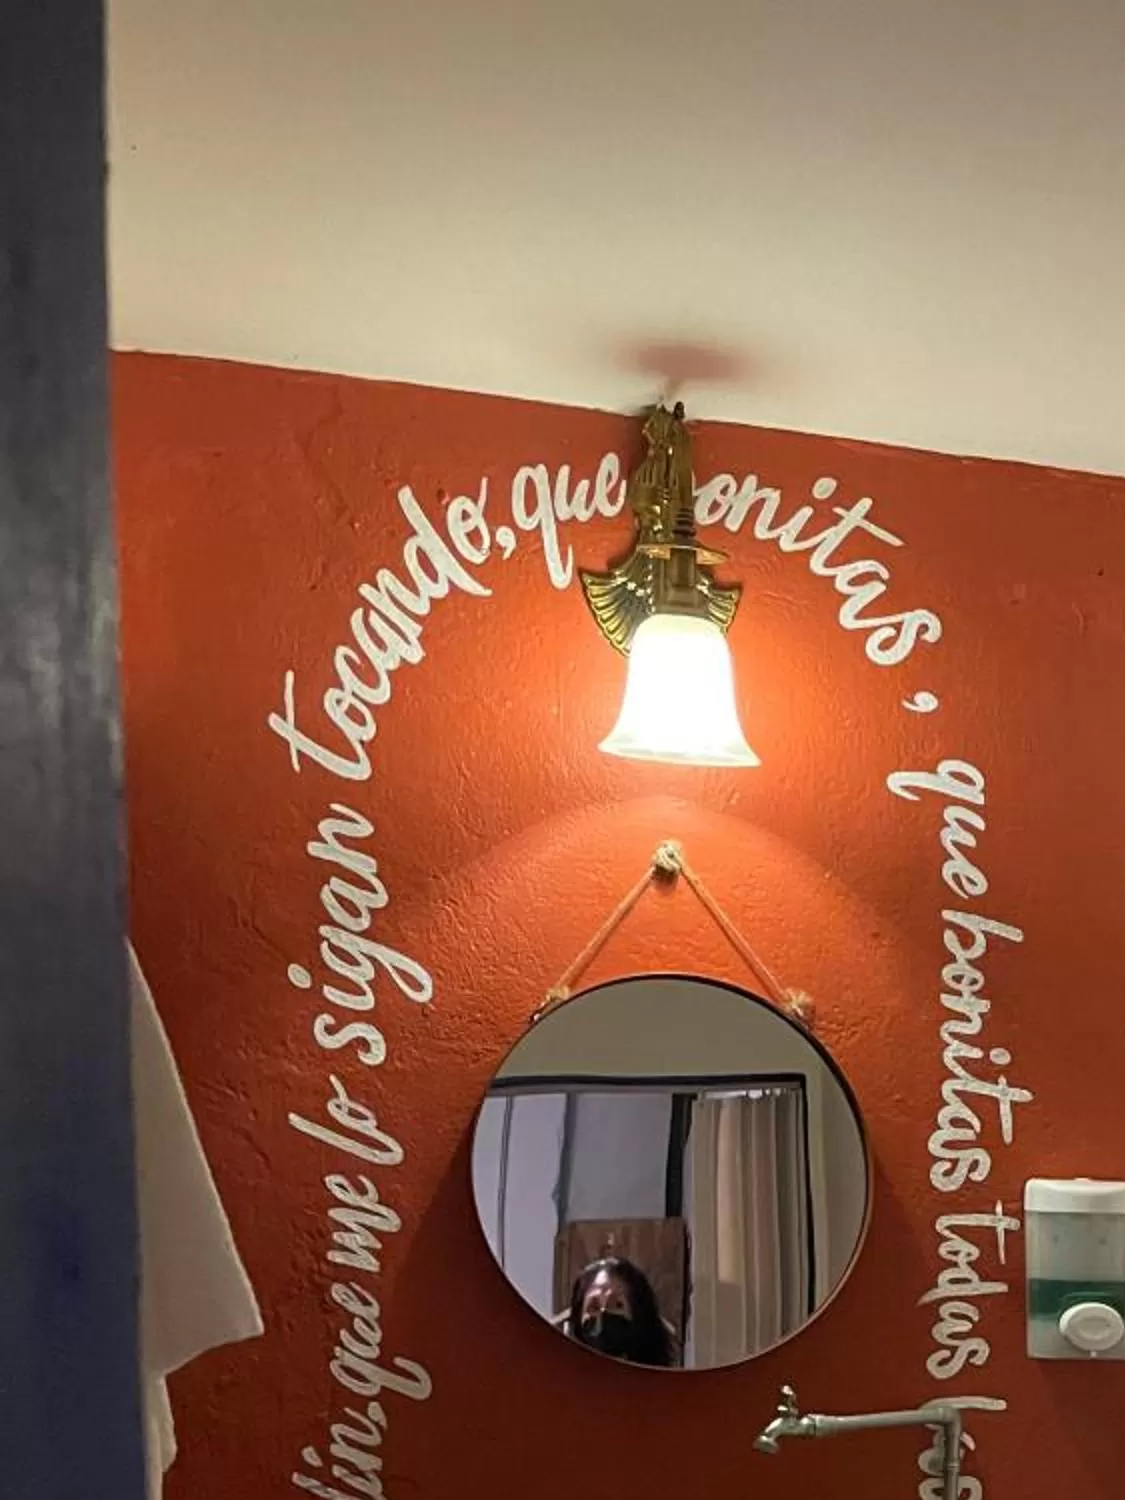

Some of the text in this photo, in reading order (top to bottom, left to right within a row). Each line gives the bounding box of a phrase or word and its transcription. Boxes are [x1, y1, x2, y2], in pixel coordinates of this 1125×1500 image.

[508, 448, 628, 590] que
[691, 471, 943, 714] onitas,
[885, 758, 990, 900] que
[286, 800, 434, 1068] sigan
[286, 1072, 405, 1166] lo
[926, 908, 1034, 1192] bonitas
[322, 1172, 402, 1274] me
[916, 1200, 1021, 1380] todas
[328, 1280, 434, 1402] que
